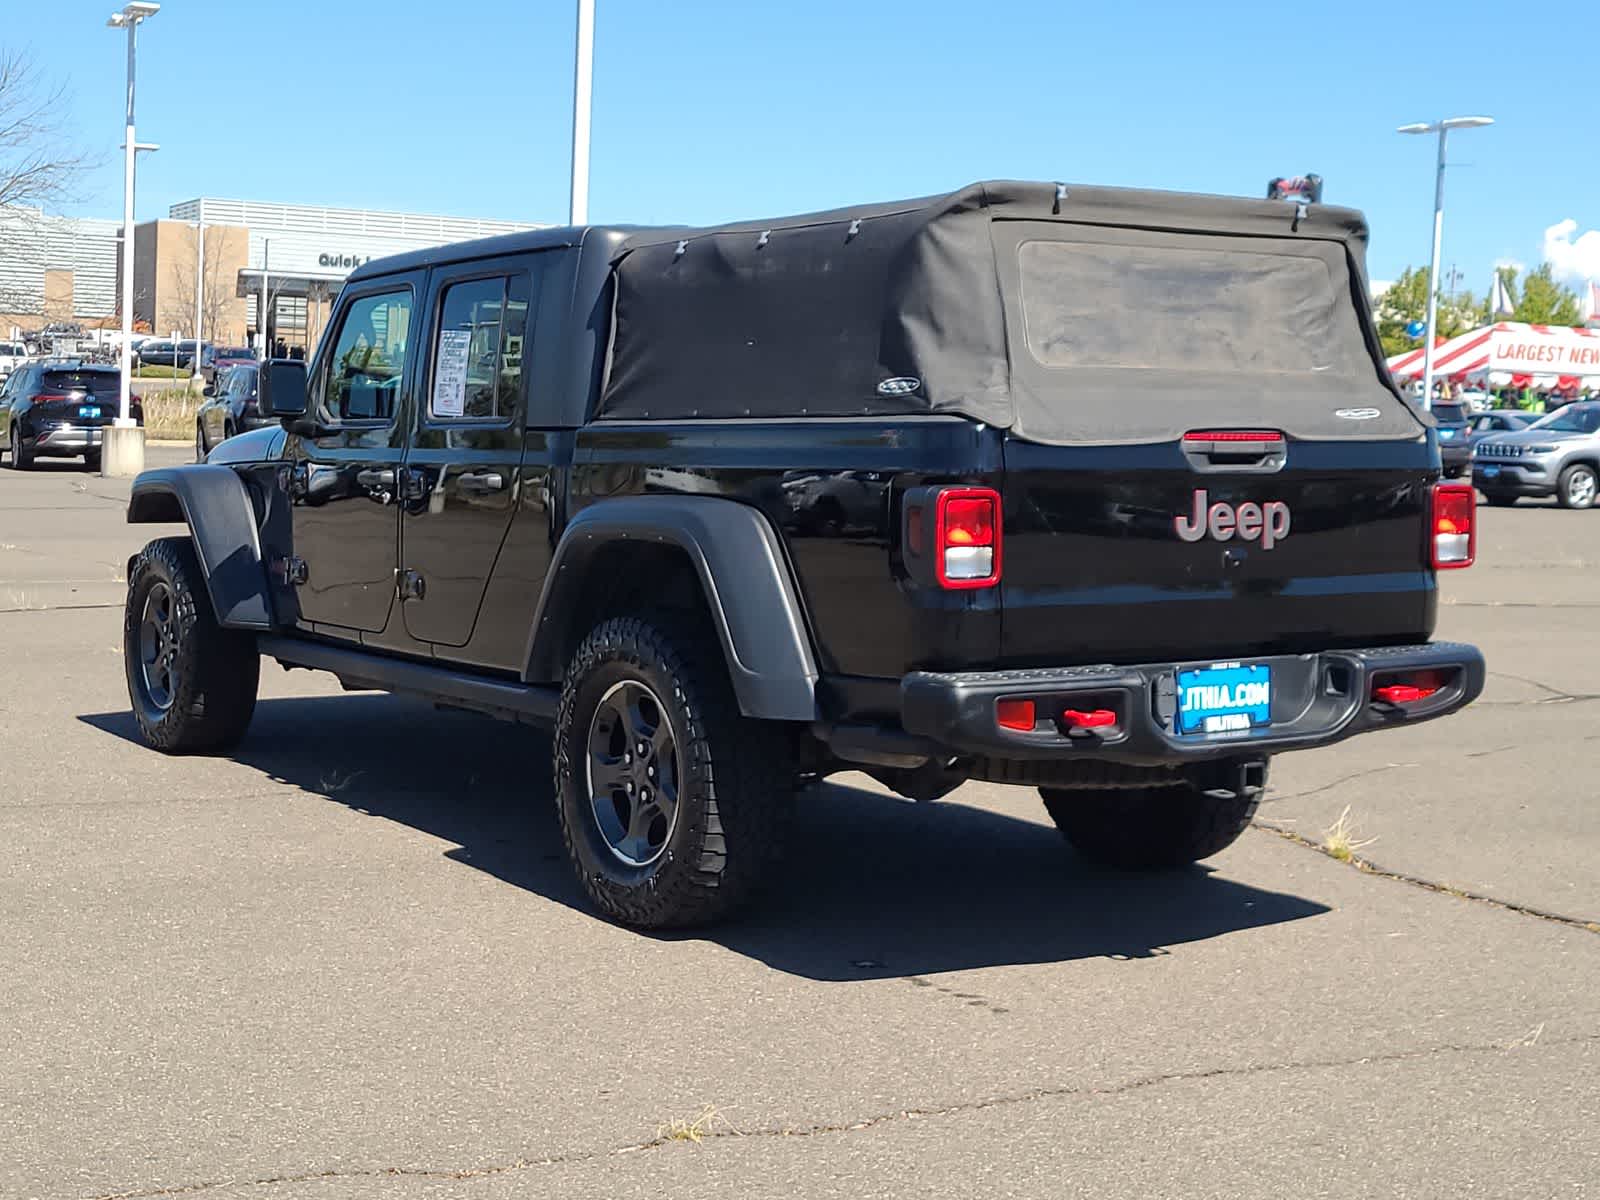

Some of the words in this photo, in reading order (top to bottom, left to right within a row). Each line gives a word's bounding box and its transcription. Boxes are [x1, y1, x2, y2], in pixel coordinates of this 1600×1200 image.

[318, 253, 361, 268] Quick
[1496, 343, 1564, 362] LARGEST
[1174, 489, 1291, 550] Jeep
